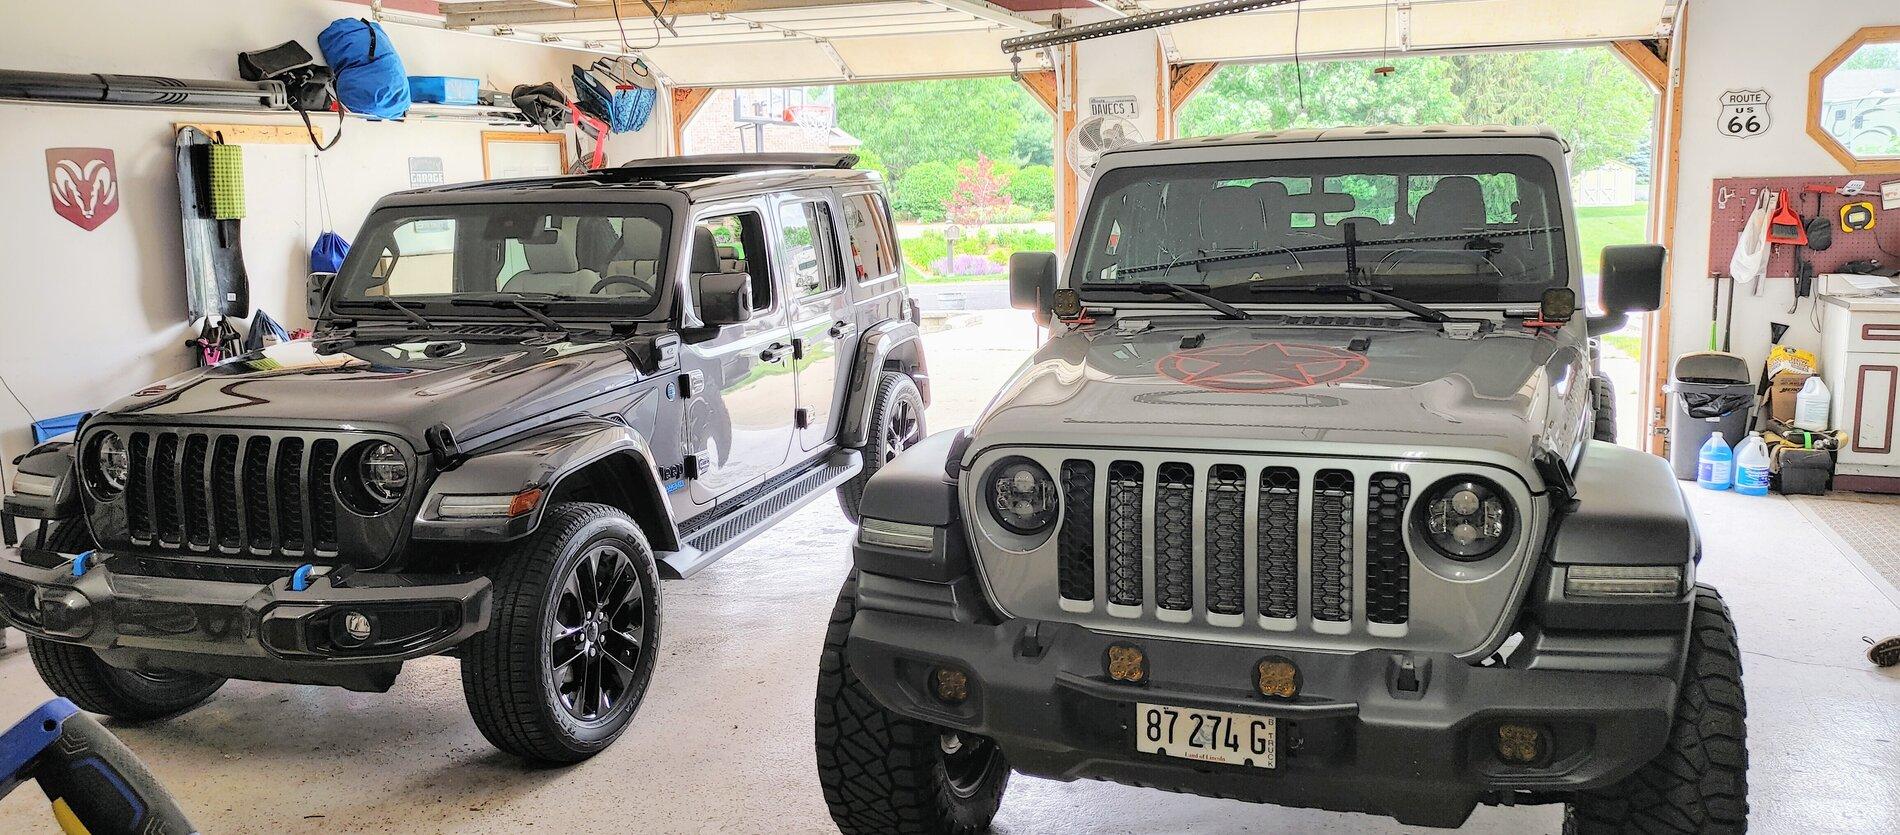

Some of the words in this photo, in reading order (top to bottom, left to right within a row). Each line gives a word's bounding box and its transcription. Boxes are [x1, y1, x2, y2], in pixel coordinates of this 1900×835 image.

[1729, 94, 1761, 103] ROUTE
[1091, 103, 1125, 116] DAVECS
[1130, 102, 1136, 114] 1
[1727, 115, 1761, 134] 66
[411, 173, 444, 183] GARAGE
[658, 463, 684, 481] Jeep
[1146, 709, 1179, 744] 87
[1188, 714, 1240, 752] 274
[1250, 720, 1267, 755] G
[1267, 732, 1275, 768] TRUCK
